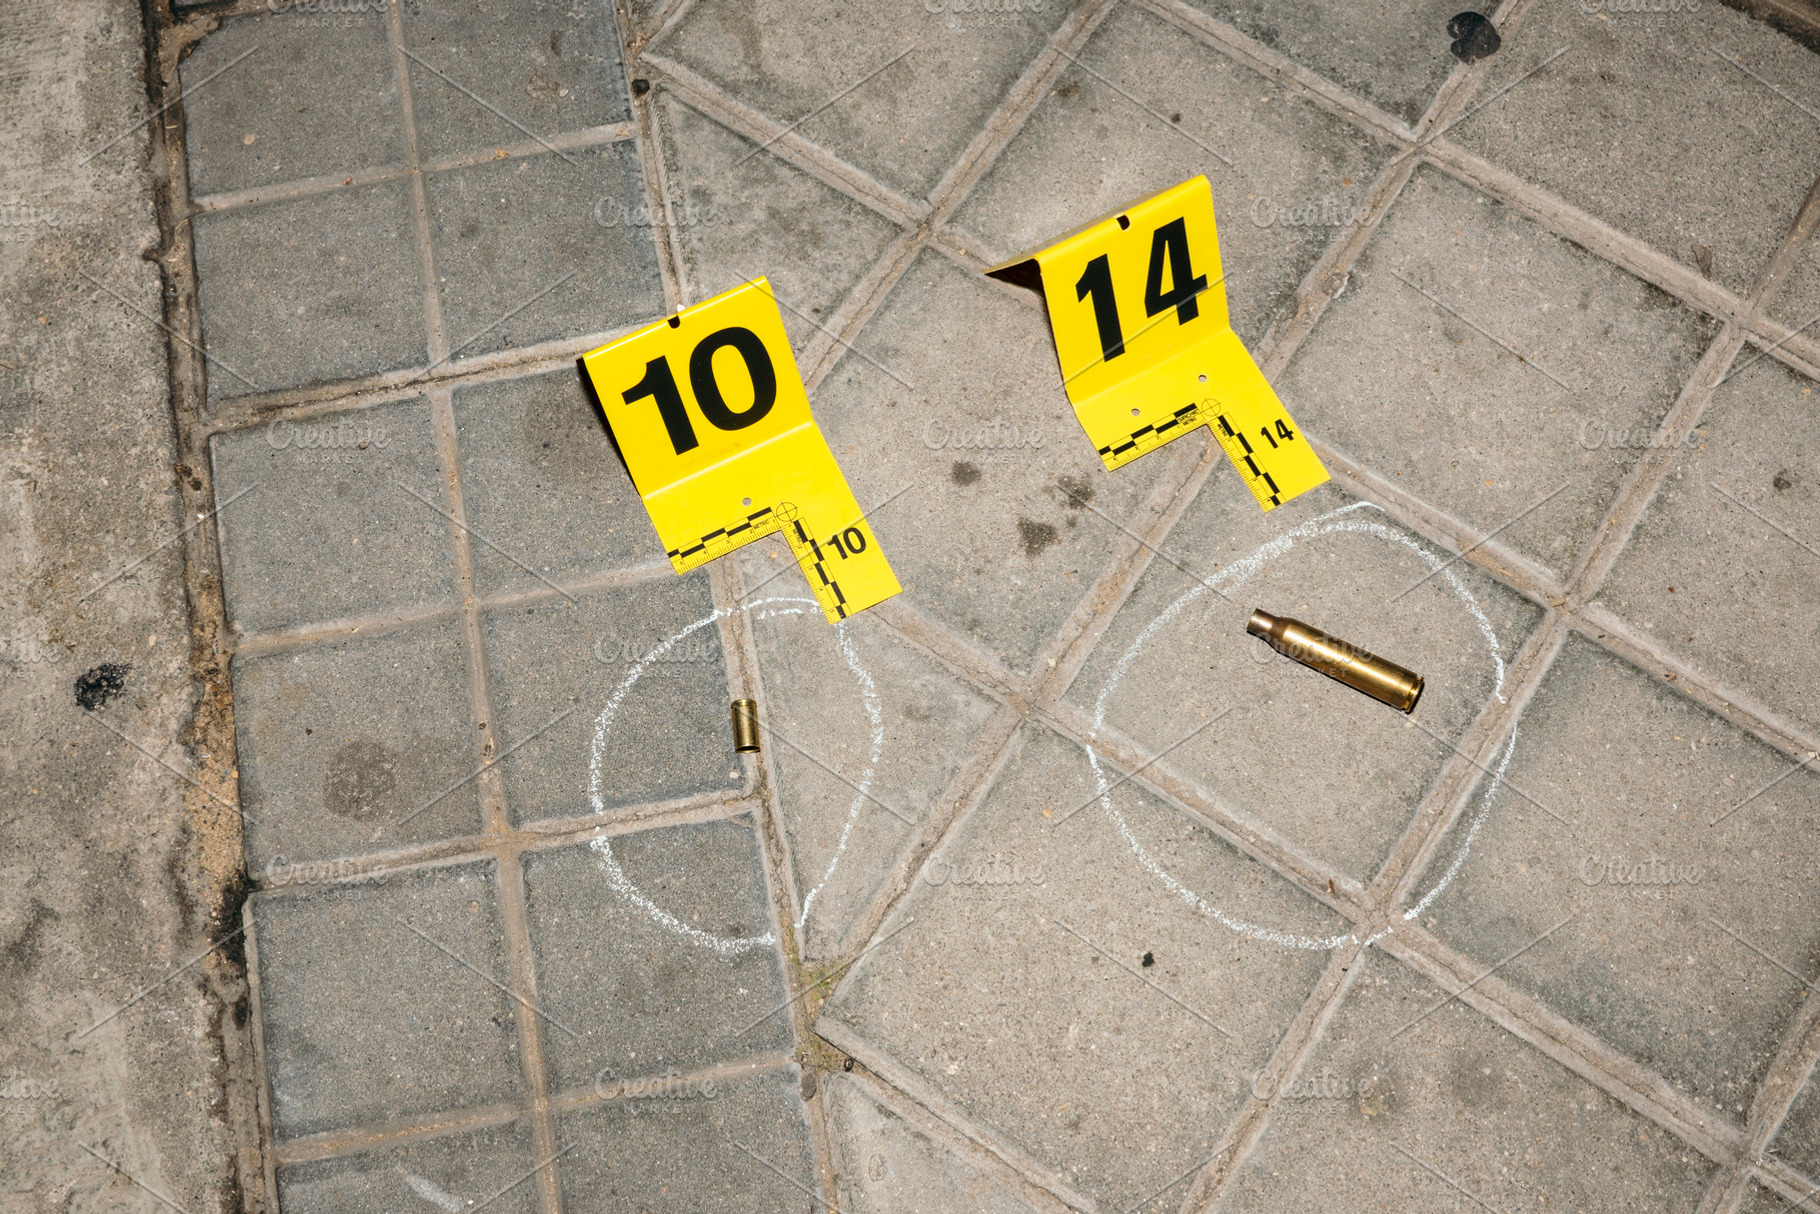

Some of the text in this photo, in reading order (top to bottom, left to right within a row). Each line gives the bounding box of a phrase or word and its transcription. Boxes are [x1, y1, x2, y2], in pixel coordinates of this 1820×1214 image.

[1075, 216, 1208, 362] 14
[621, 326, 777, 456] 10
[1260, 419, 1294, 449] 14
[752, 519, 770, 530] METRIC
[827, 527, 867, 560] 10
